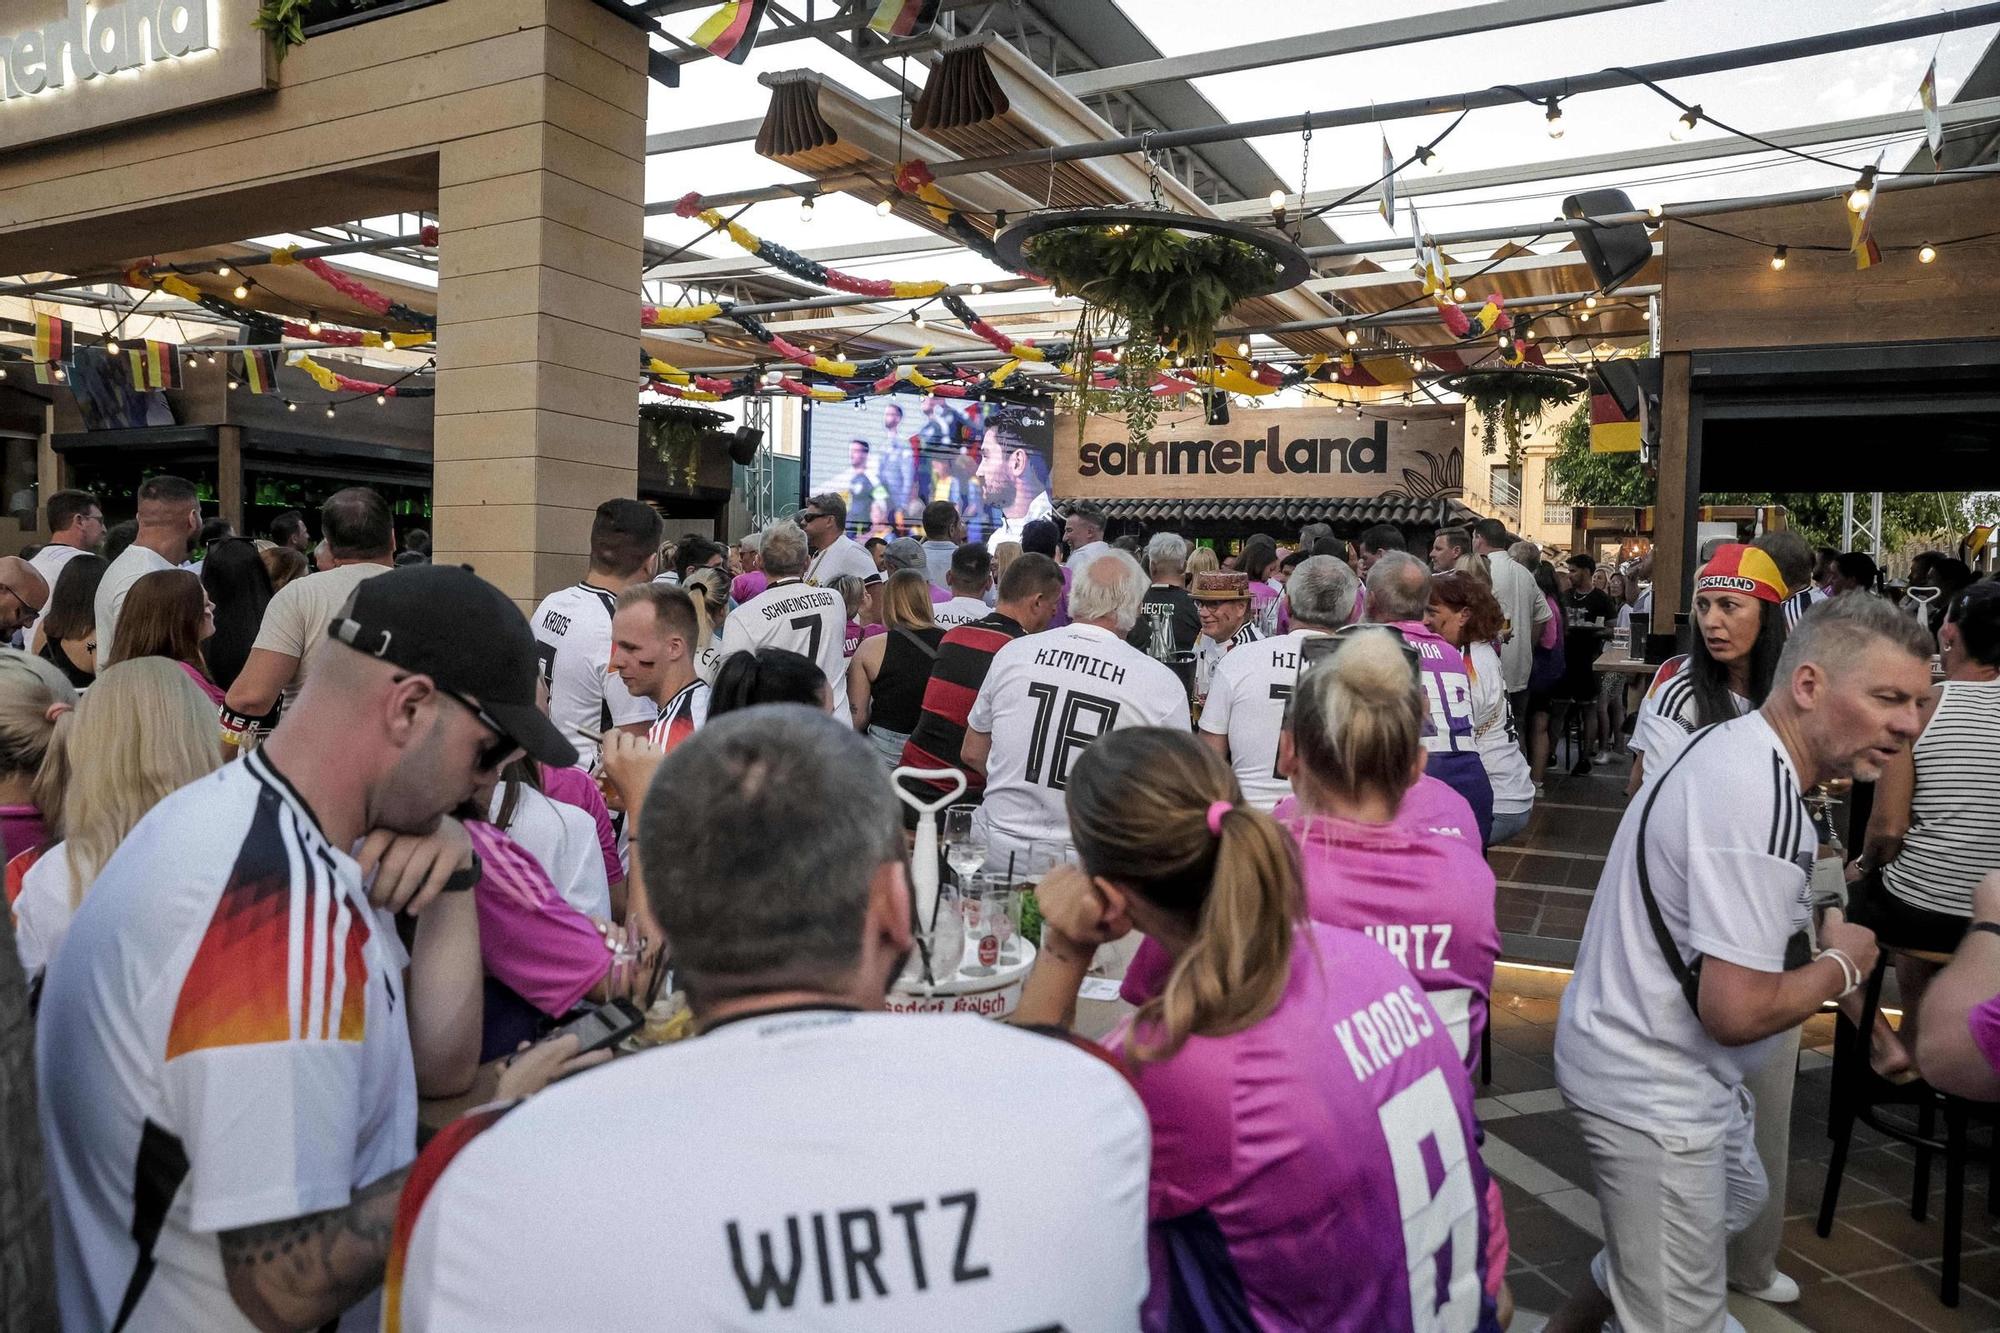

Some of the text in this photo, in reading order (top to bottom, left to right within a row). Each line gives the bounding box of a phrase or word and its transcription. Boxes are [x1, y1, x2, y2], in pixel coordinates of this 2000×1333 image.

[0, 0, 210, 98] erland
[1078, 420, 1389, 477] sommerland
[542, 610, 571, 636] KROOS
[761, 592, 835, 621] SCHWEINSTEIGER
[1140, 603, 1175, 616] HECTOR
[790, 613, 823, 664] 7
[1034, 648, 1126, 685] KIMMICH
[1333, 985, 1435, 1083] KROOS
[726, 1190, 991, 1312] WIRTZ
